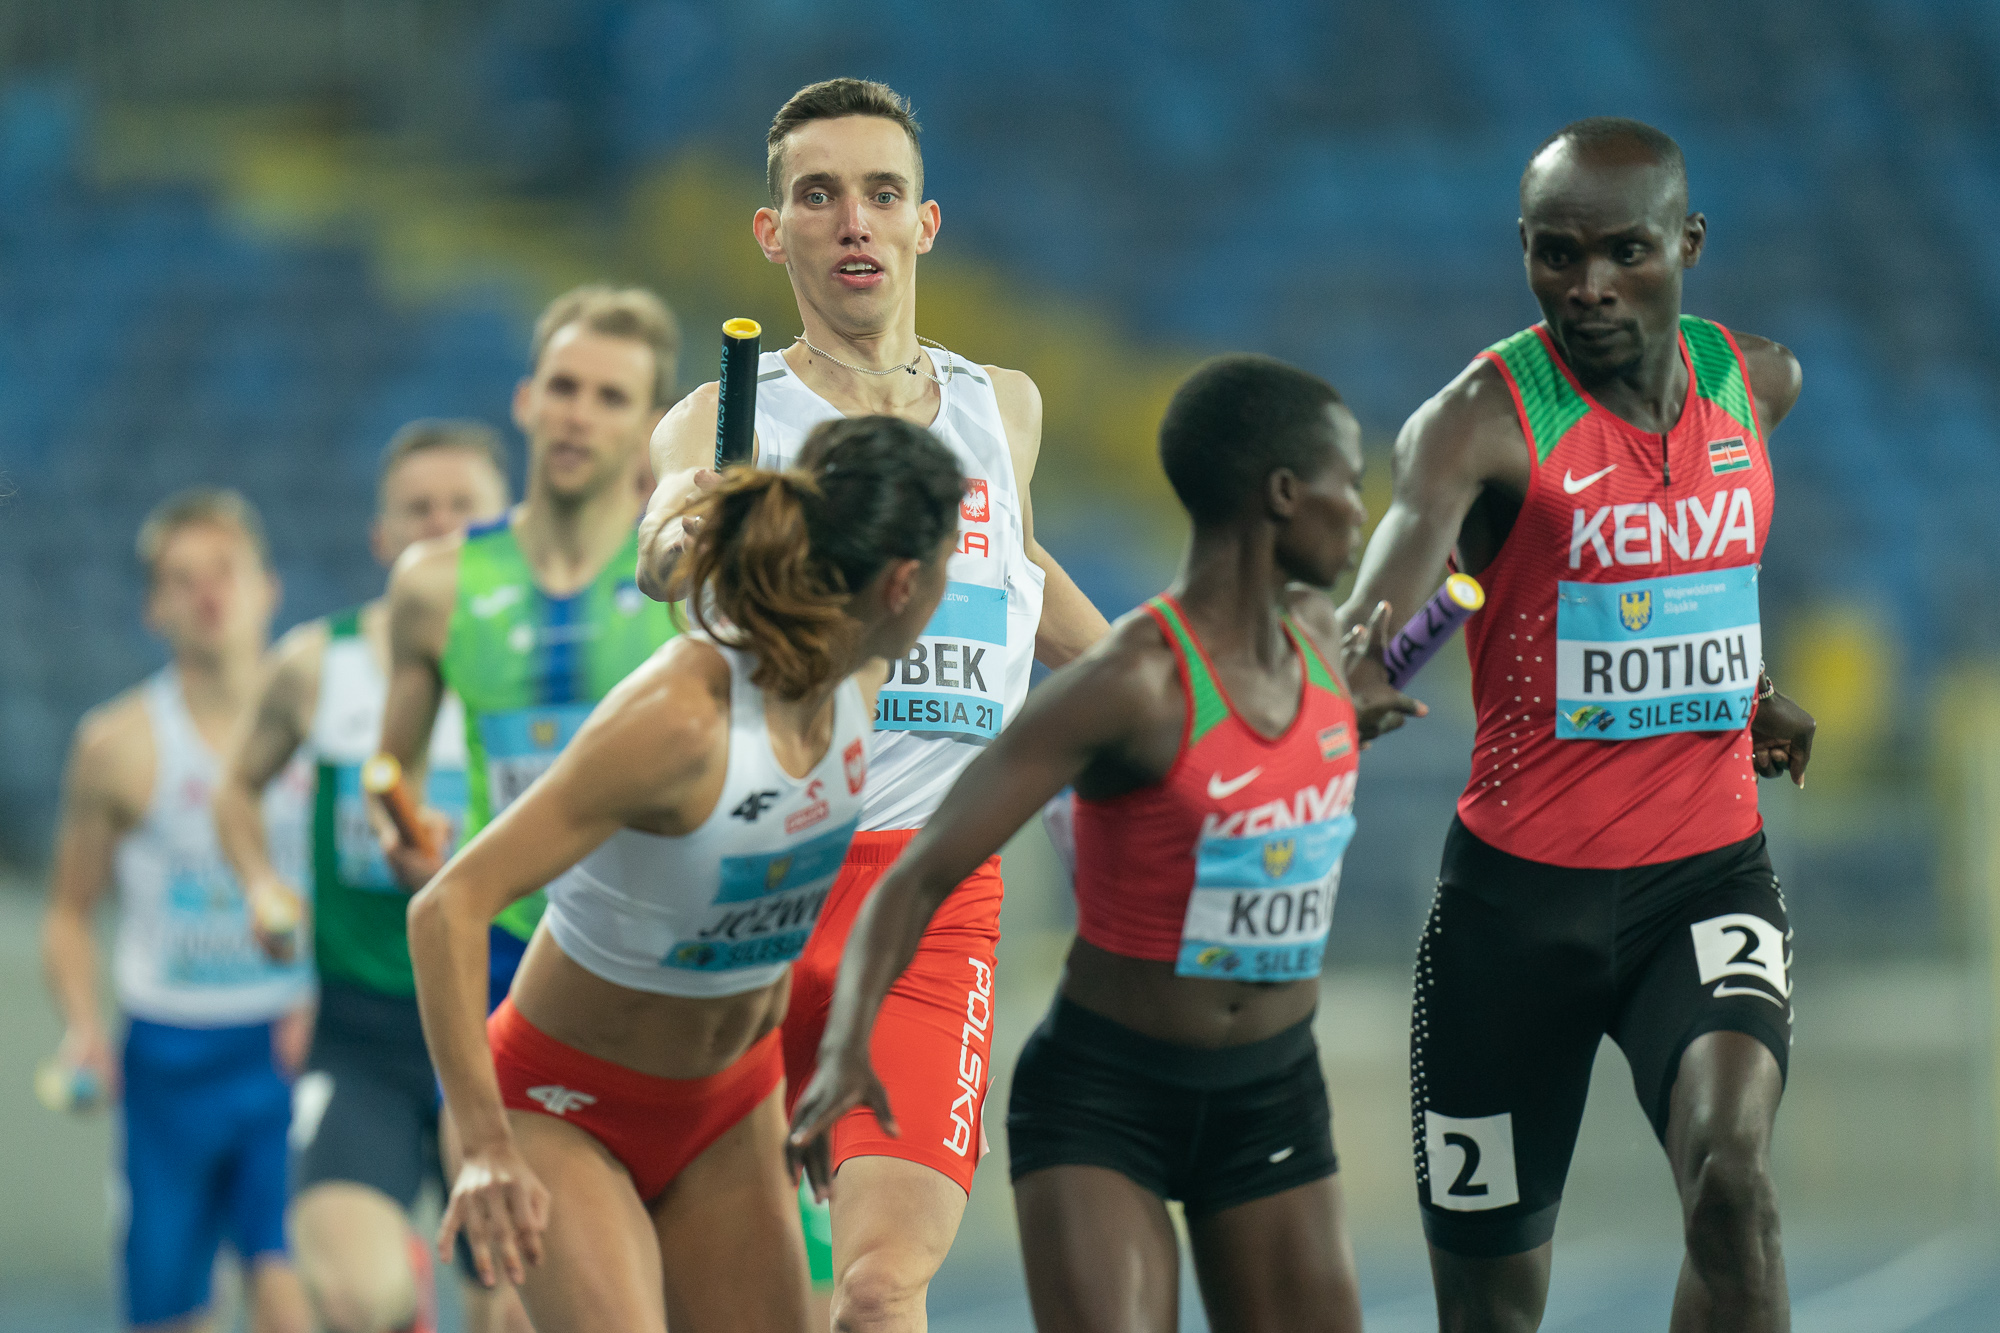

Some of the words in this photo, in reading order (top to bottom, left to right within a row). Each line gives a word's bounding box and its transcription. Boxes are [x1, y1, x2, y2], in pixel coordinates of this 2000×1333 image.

[719, 344, 729, 402] RELAYS
[1569, 487, 1756, 570] KENYA
[1583, 635, 1749, 694] ROTICH
[975, 705, 993, 730] 21
[1628, 699, 1733, 730] SILESIA
[1740, 694, 1753, 719] 2
[730, 789, 780, 823] 4F
[1720, 924, 1767, 970] 2
[942, 957, 992, 1157] POLSKA
[526, 1085, 597, 1115] 4F
[1443, 1131, 1490, 1197] 2
